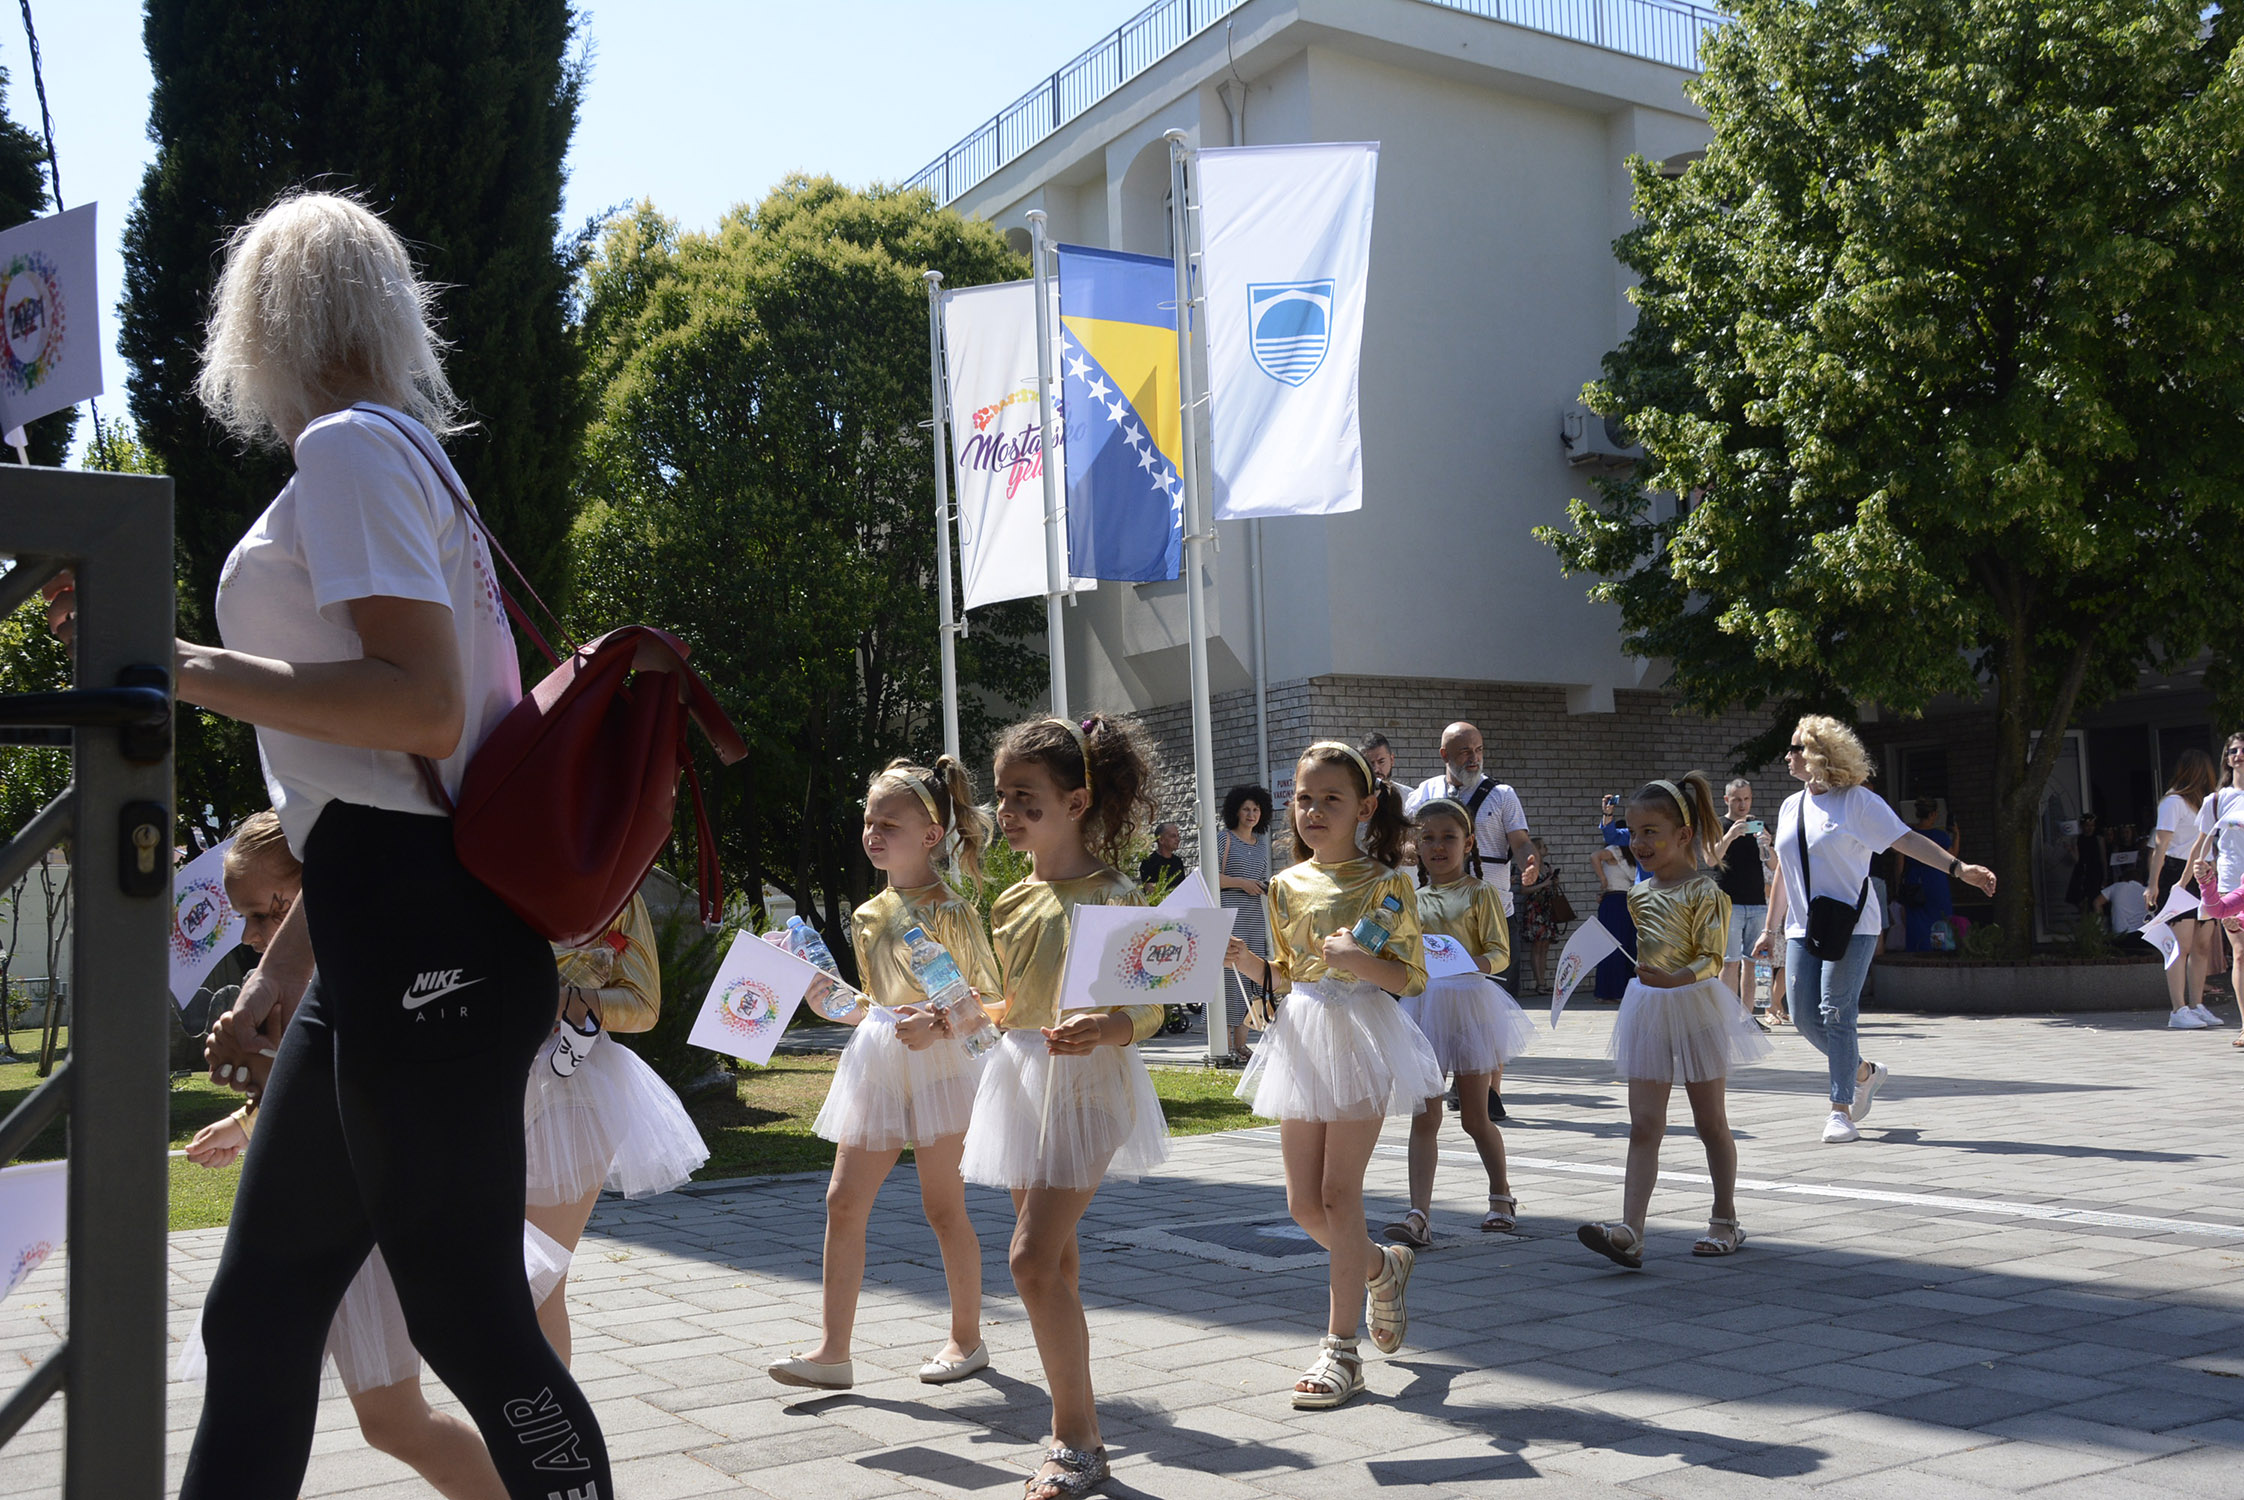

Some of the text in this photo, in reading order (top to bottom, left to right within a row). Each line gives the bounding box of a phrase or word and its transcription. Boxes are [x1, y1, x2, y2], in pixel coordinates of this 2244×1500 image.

[1146, 945, 1183, 962] 2021
[412, 968, 463, 992] NIKE
[416, 1006, 468, 1022] AIR
[503, 1386, 591, 1471] AIR
